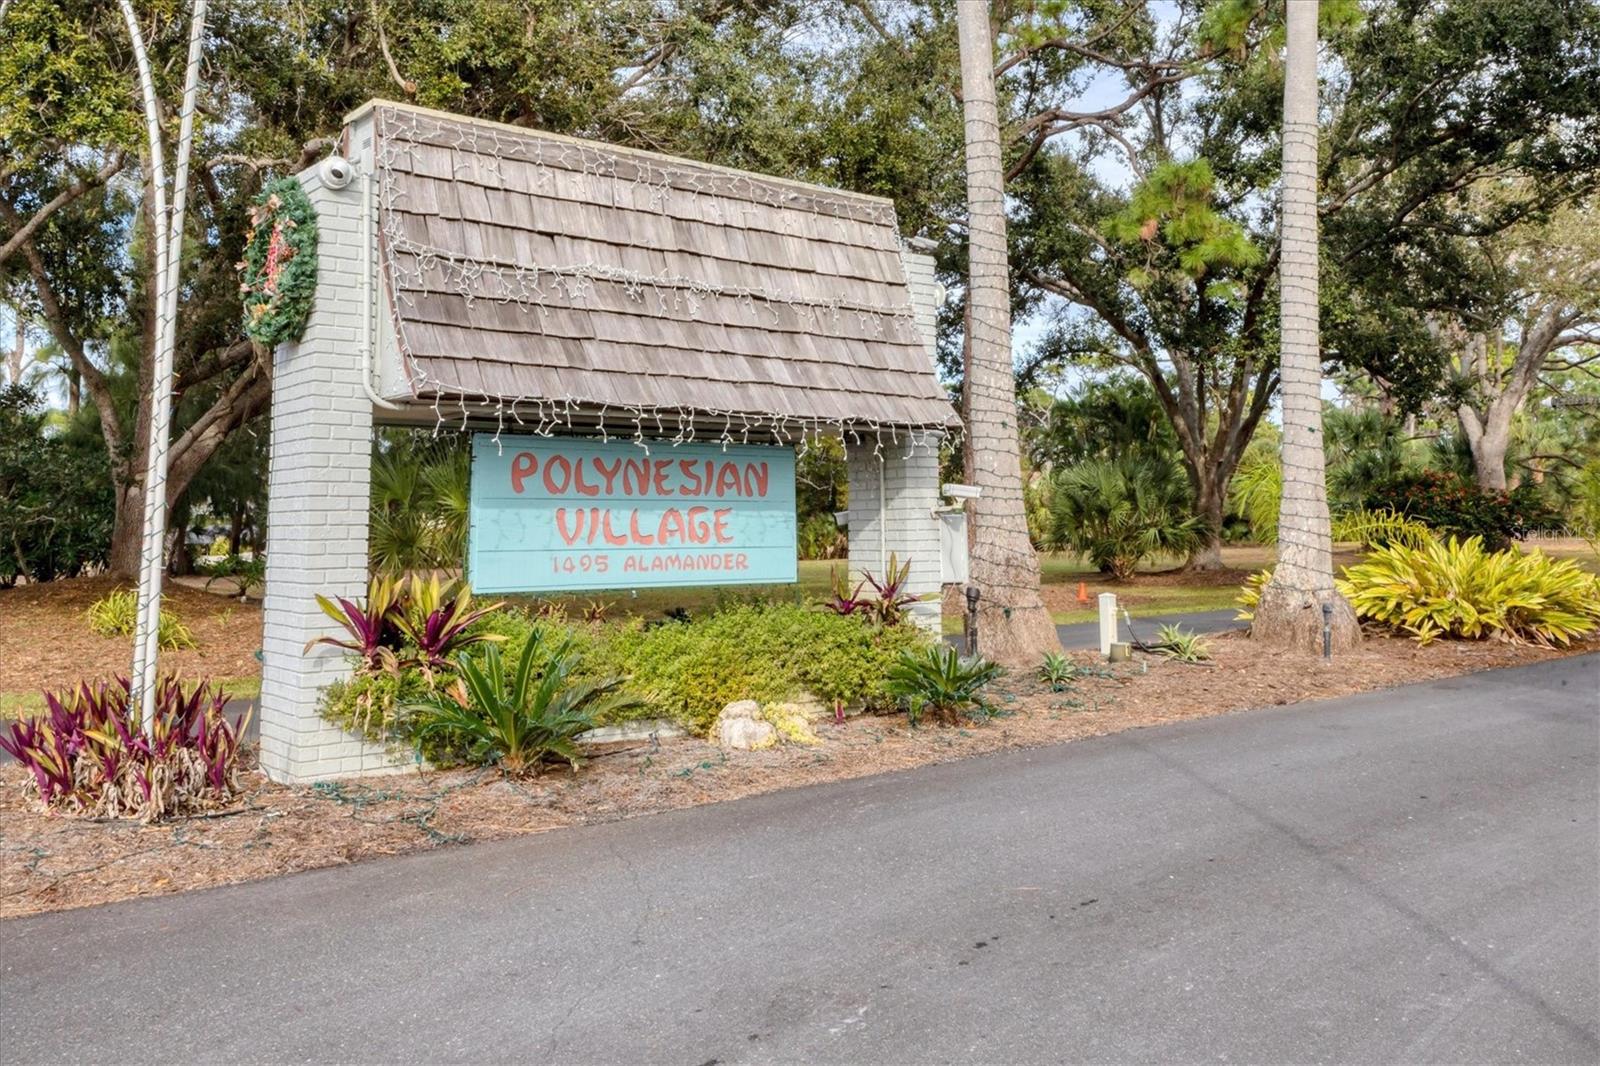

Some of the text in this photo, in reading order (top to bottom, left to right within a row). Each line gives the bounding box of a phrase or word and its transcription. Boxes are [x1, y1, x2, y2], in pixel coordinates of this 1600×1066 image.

[511, 452, 769, 497] POLYNESIAN
[555, 506, 734, 546] VILLAGE
[552, 553, 749, 573] 1495 ALAMANDER
